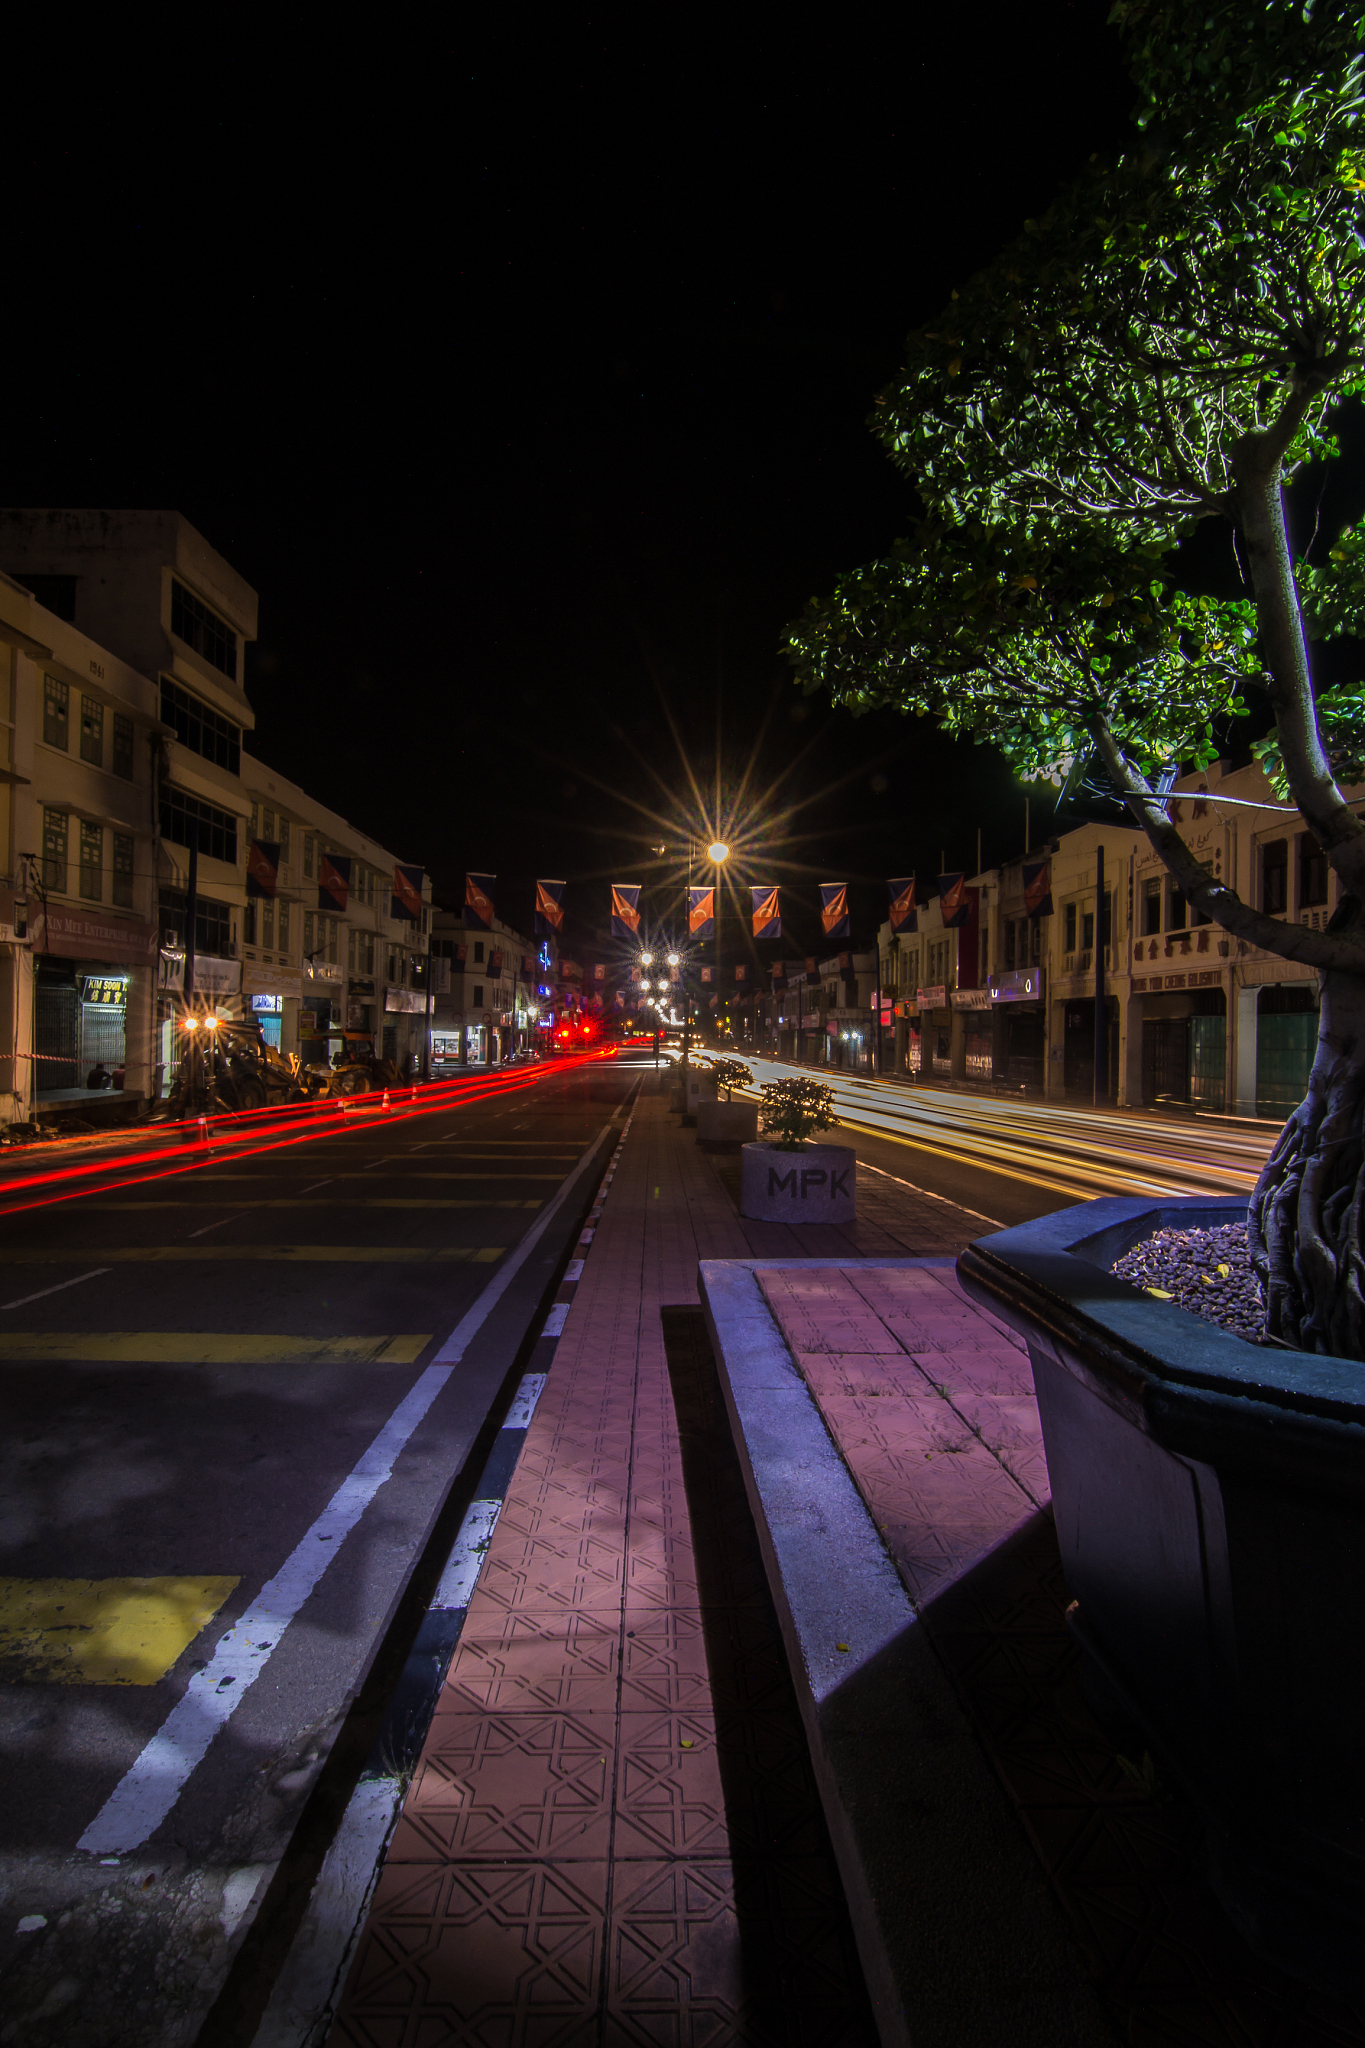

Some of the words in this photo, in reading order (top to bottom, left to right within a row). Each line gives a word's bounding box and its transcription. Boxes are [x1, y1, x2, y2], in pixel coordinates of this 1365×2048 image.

[90, 660, 104, 679] 1941
[65, 918, 82, 934] MEE
[84, 922, 128, 942] ENTERPRISE
[88, 979, 102, 989] KIM
[103, 981, 121, 991] SOON
[768, 1167, 850, 1199] MPK
